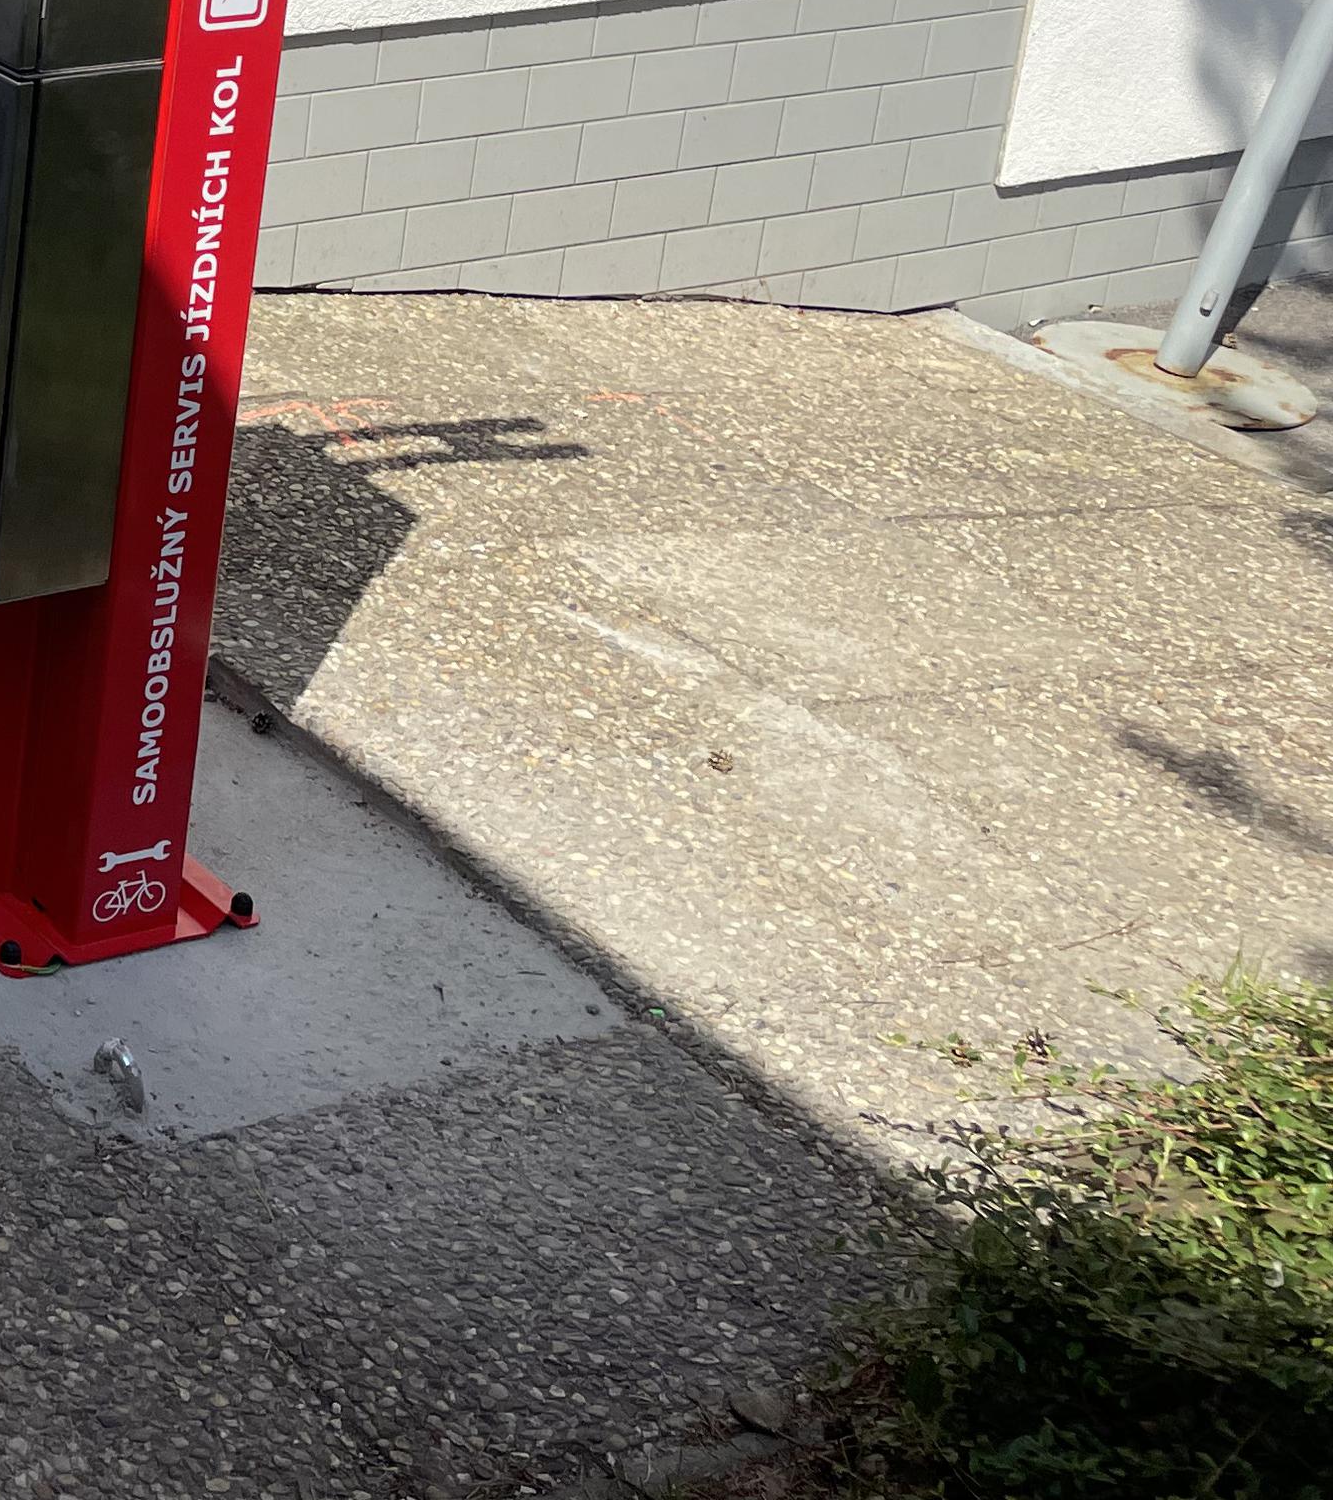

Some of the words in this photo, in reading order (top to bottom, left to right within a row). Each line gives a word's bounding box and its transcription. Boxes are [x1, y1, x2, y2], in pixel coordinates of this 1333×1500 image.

[208, 55, 243, 136] KOL
[179, 150, 232, 342] JÍZDNÍCH
[168, 353, 206, 494] SERVIS
[132, 507, 188, 805] SAMOOBSLUŽNÝ
